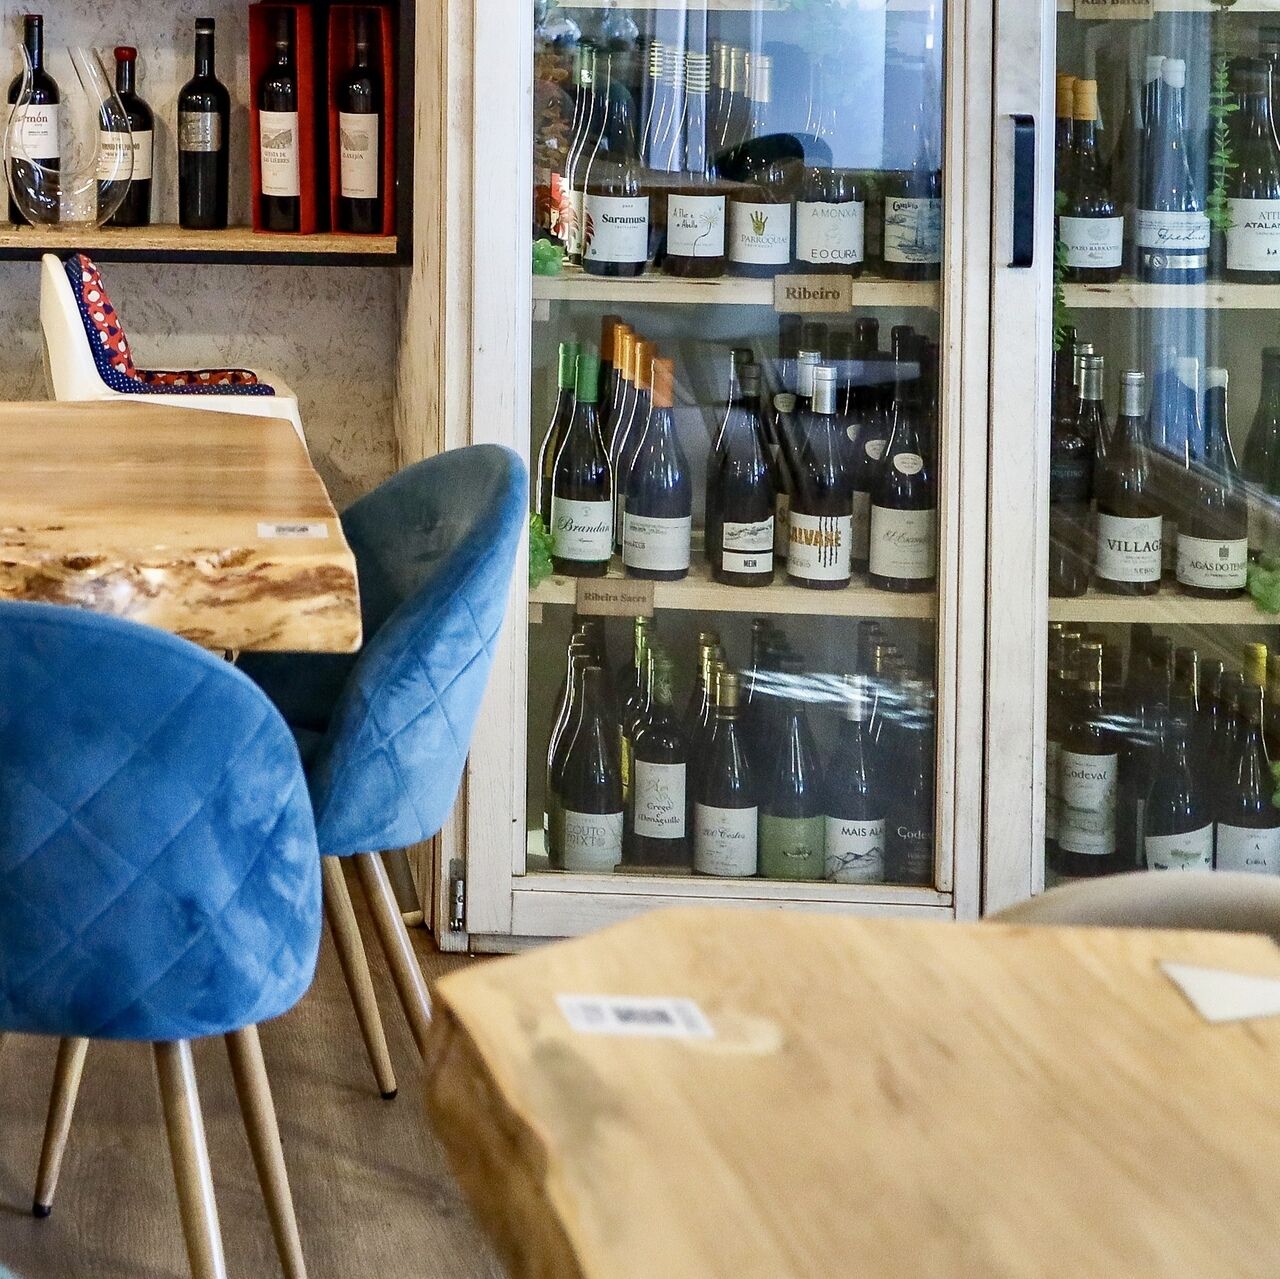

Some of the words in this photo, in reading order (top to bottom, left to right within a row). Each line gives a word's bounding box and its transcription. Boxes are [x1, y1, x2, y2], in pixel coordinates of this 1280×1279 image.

[811, 209, 820, 218] A
[822, 208, 858, 218] MONXA
[602, 214, 646, 224] Saramusa
[811, 249, 818, 258] E
[819, 250, 829, 259] O
[831, 249, 858, 259] CURA
[786, 287, 840, 300] Ribeiro
[584, 593, 618, 602] Ribeira
[620, 593, 647, 602] Sacra
[841, 826, 866, 837] MAIS
